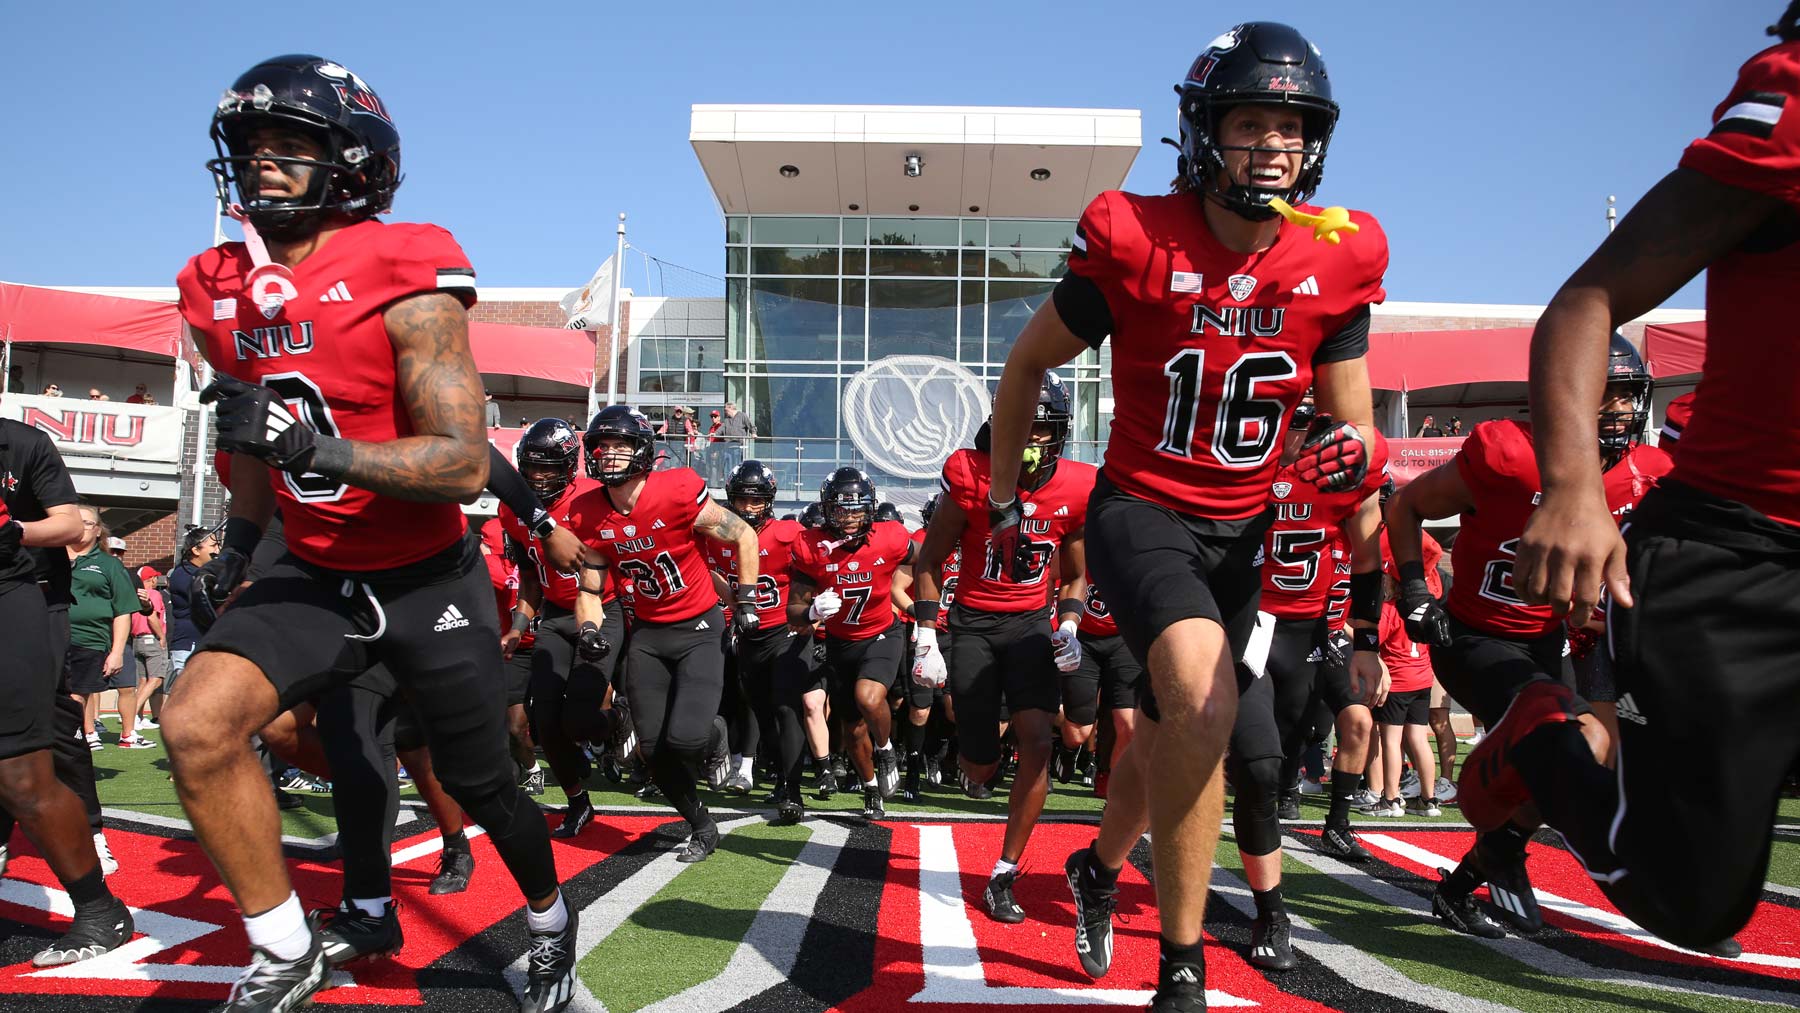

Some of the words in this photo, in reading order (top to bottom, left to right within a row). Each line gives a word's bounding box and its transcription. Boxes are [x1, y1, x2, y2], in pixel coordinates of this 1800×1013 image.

[1189, 304, 1286, 337] NIU
[231, 320, 315, 360] NIU
[1153, 348, 1297, 467] 16
[22, 406, 146, 447] NIU
[1401, 448, 1426, 457] CALL
[1429, 447, 1463, 457] 815-75
[1393, 459, 1409, 467] GO
[1412, 459, 1426, 467] TO
[1274, 503, 1313, 521] IU
[1020, 519, 1051, 534] IU
[613, 535, 656, 554] NIU
[1271, 527, 1326, 590] 5
[836, 571, 872, 585] NIU
[842, 585, 873, 625] 7
[433, 618, 470, 632] adidas
